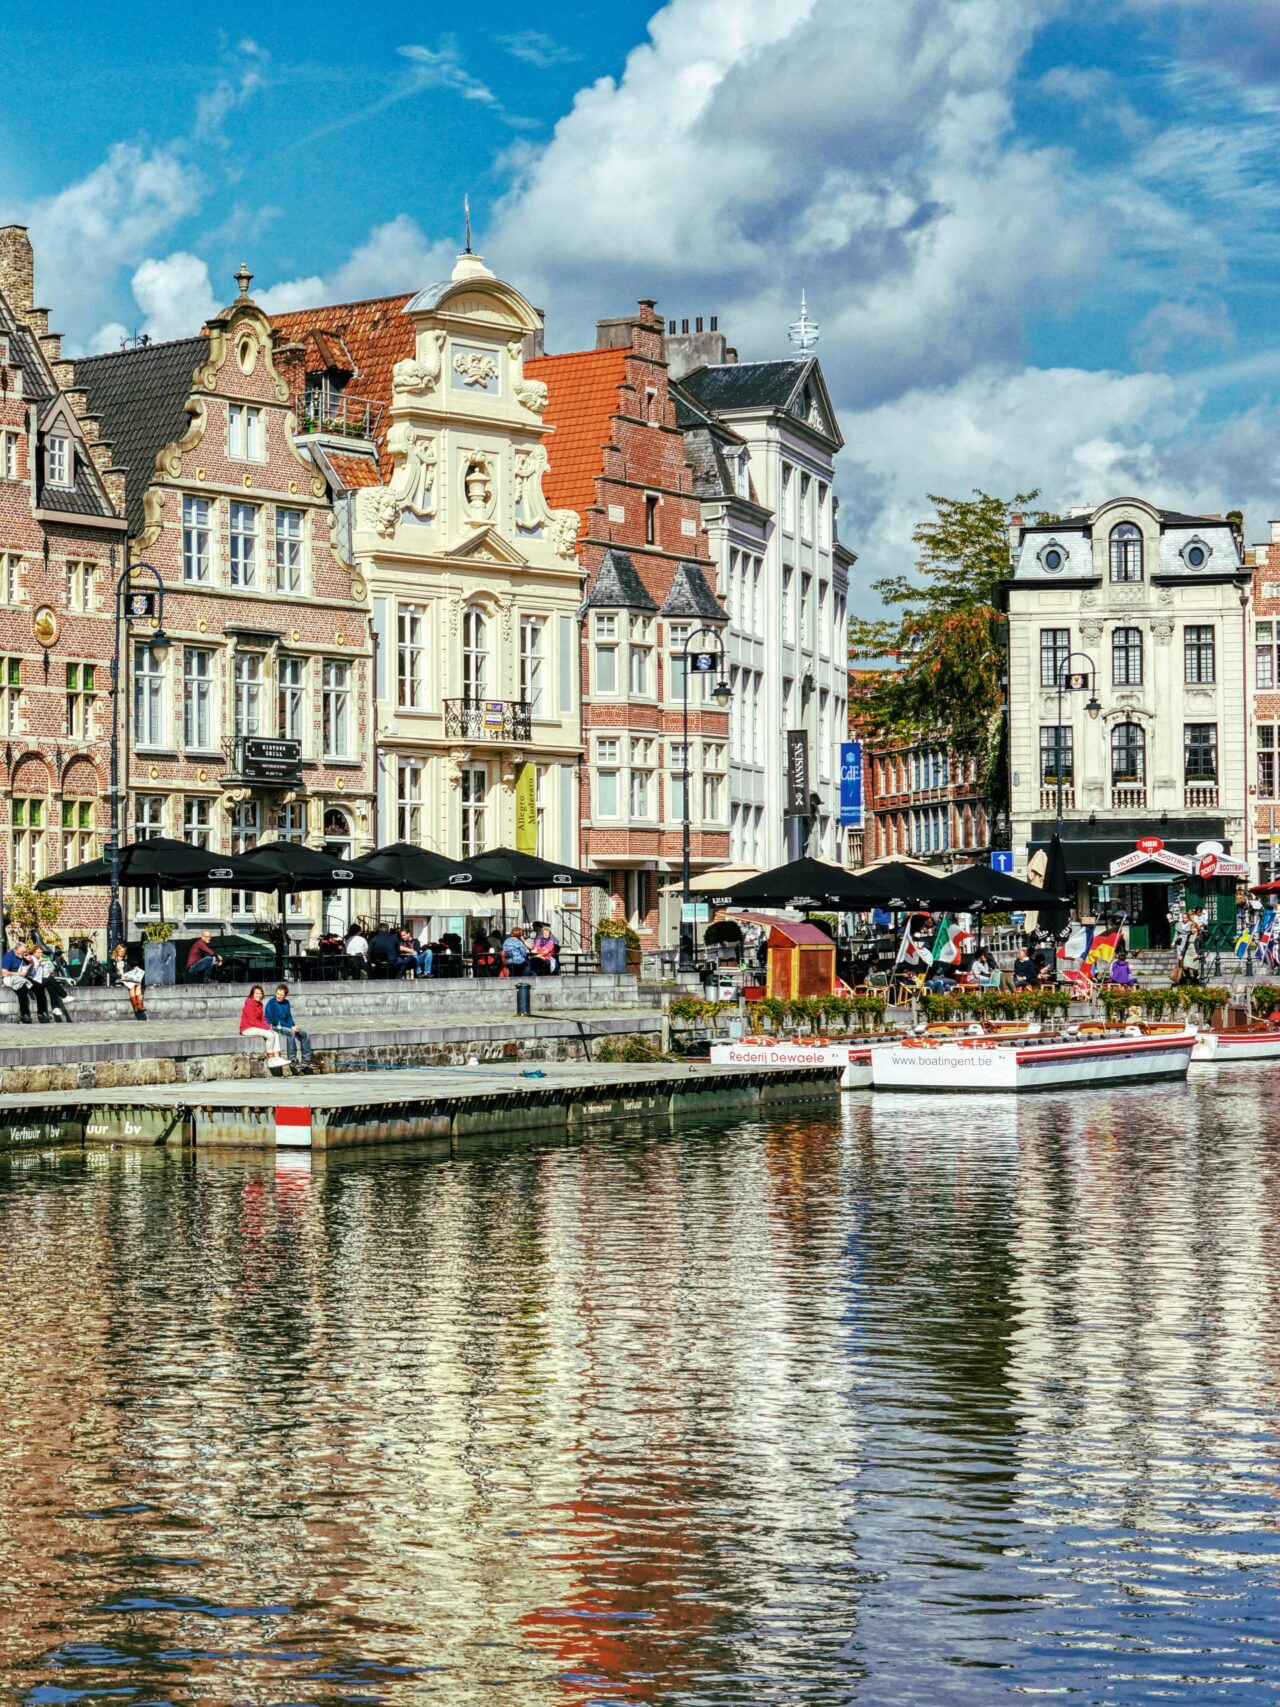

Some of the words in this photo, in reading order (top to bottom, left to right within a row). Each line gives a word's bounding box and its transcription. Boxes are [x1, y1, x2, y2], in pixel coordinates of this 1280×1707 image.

[794, 742, 804, 788] JANSSENS
[528, 778, 536, 825] Moderato
[518, 795, 527, 831] Allegro
[1116, 854, 1140, 868] TICKETS
[1157, 852, 1190, 868] BOOTTRIPS
[729, 1051, 767, 1064] Rederij
[771, 1052, 825, 1063] Dewaele
[892, 1056, 992, 1068] www.boatingent.be
[10, 1127, 41, 1141] Verhuur
[50, 1125, 60, 1138] bv
[125, 1121, 141, 1135] bv
